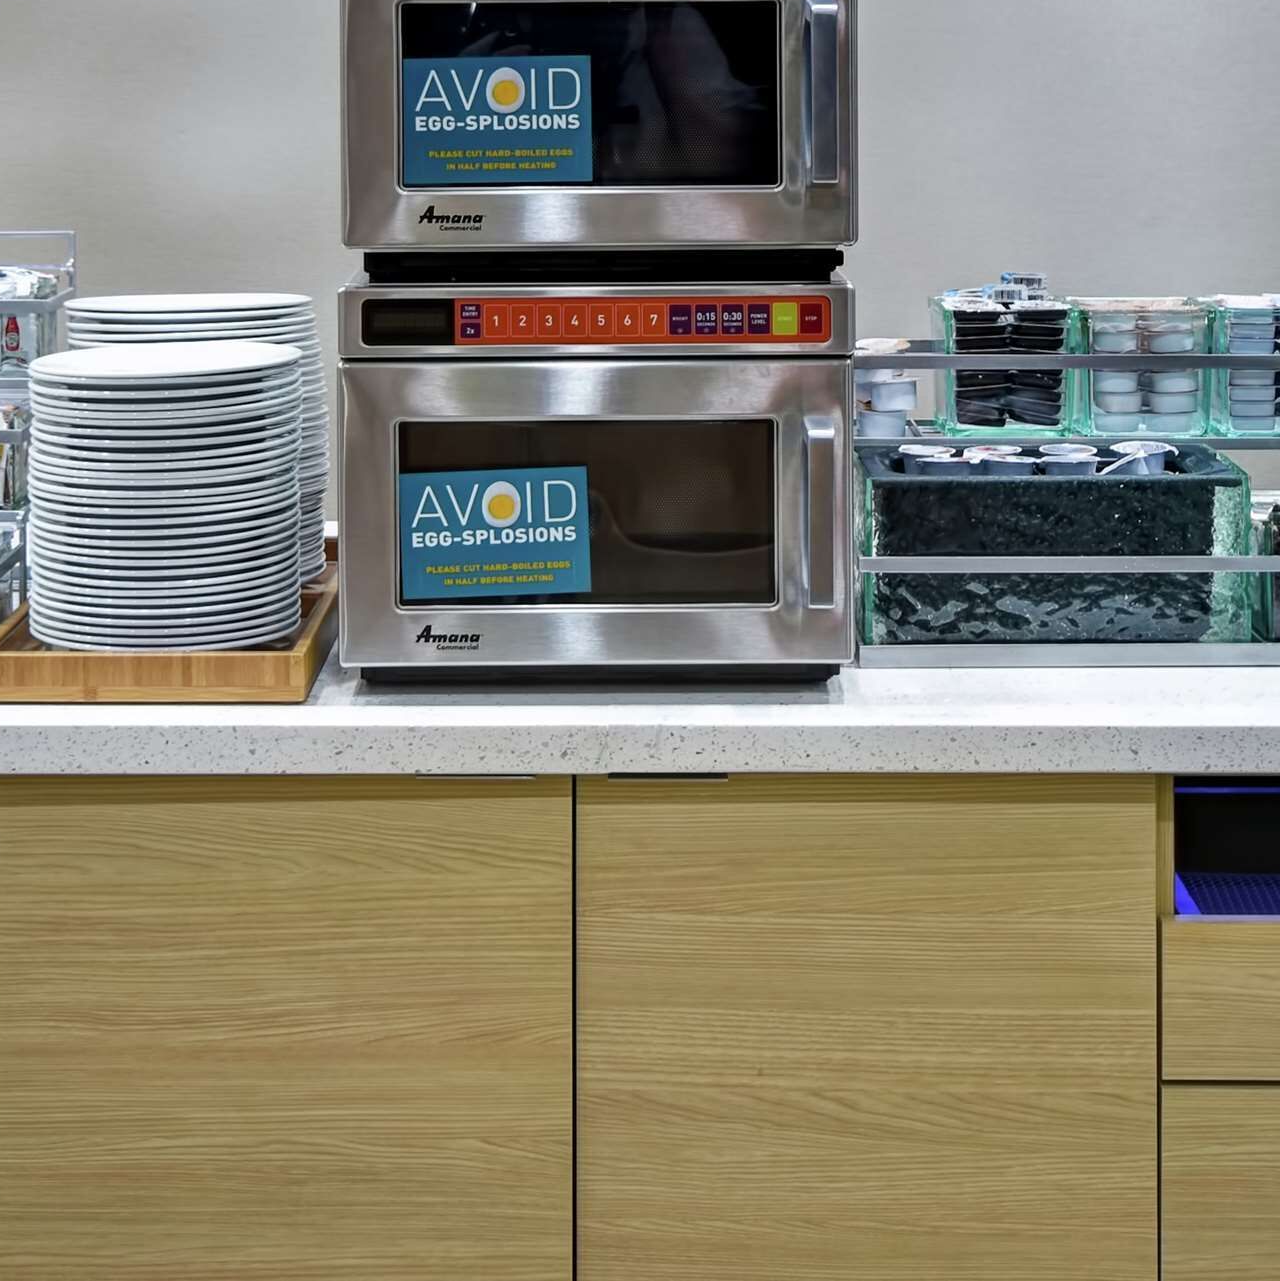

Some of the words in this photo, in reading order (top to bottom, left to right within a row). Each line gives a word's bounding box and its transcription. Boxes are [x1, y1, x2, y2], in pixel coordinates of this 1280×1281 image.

[415, 66, 581, 114] AVOID
[415, 114, 580, 132] EGG-SPLOSIONS
[428, 150, 463, 159] PLEASE
[457, 162, 481, 171] HALF
[418, 205, 483, 224] Amana
[439, 224, 482, 232] Commercial
[493, 315, 499, 327] 1
[519, 315, 527, 327] 2
[545, 315, 553, 327] 3
[571, 315, 579, 326] 4
[597, 315, 605, 326] 5
[623, 314, 632, 326] 6
[650, 314, 658, 326] 7
[696, 312, 716, 321] 0:15
[723, 312, 742, 321] 0:30
[411, 480, 577, 528] AVOID
[412, 526, 577, 548] EGG-SPLOSIONS
[425, 565, 461, 574] PLEASE
[455, 577, 477, 585] HALF
[416, 624, 481, 643] Amana
[436, 643, 479, 651] Commercial
